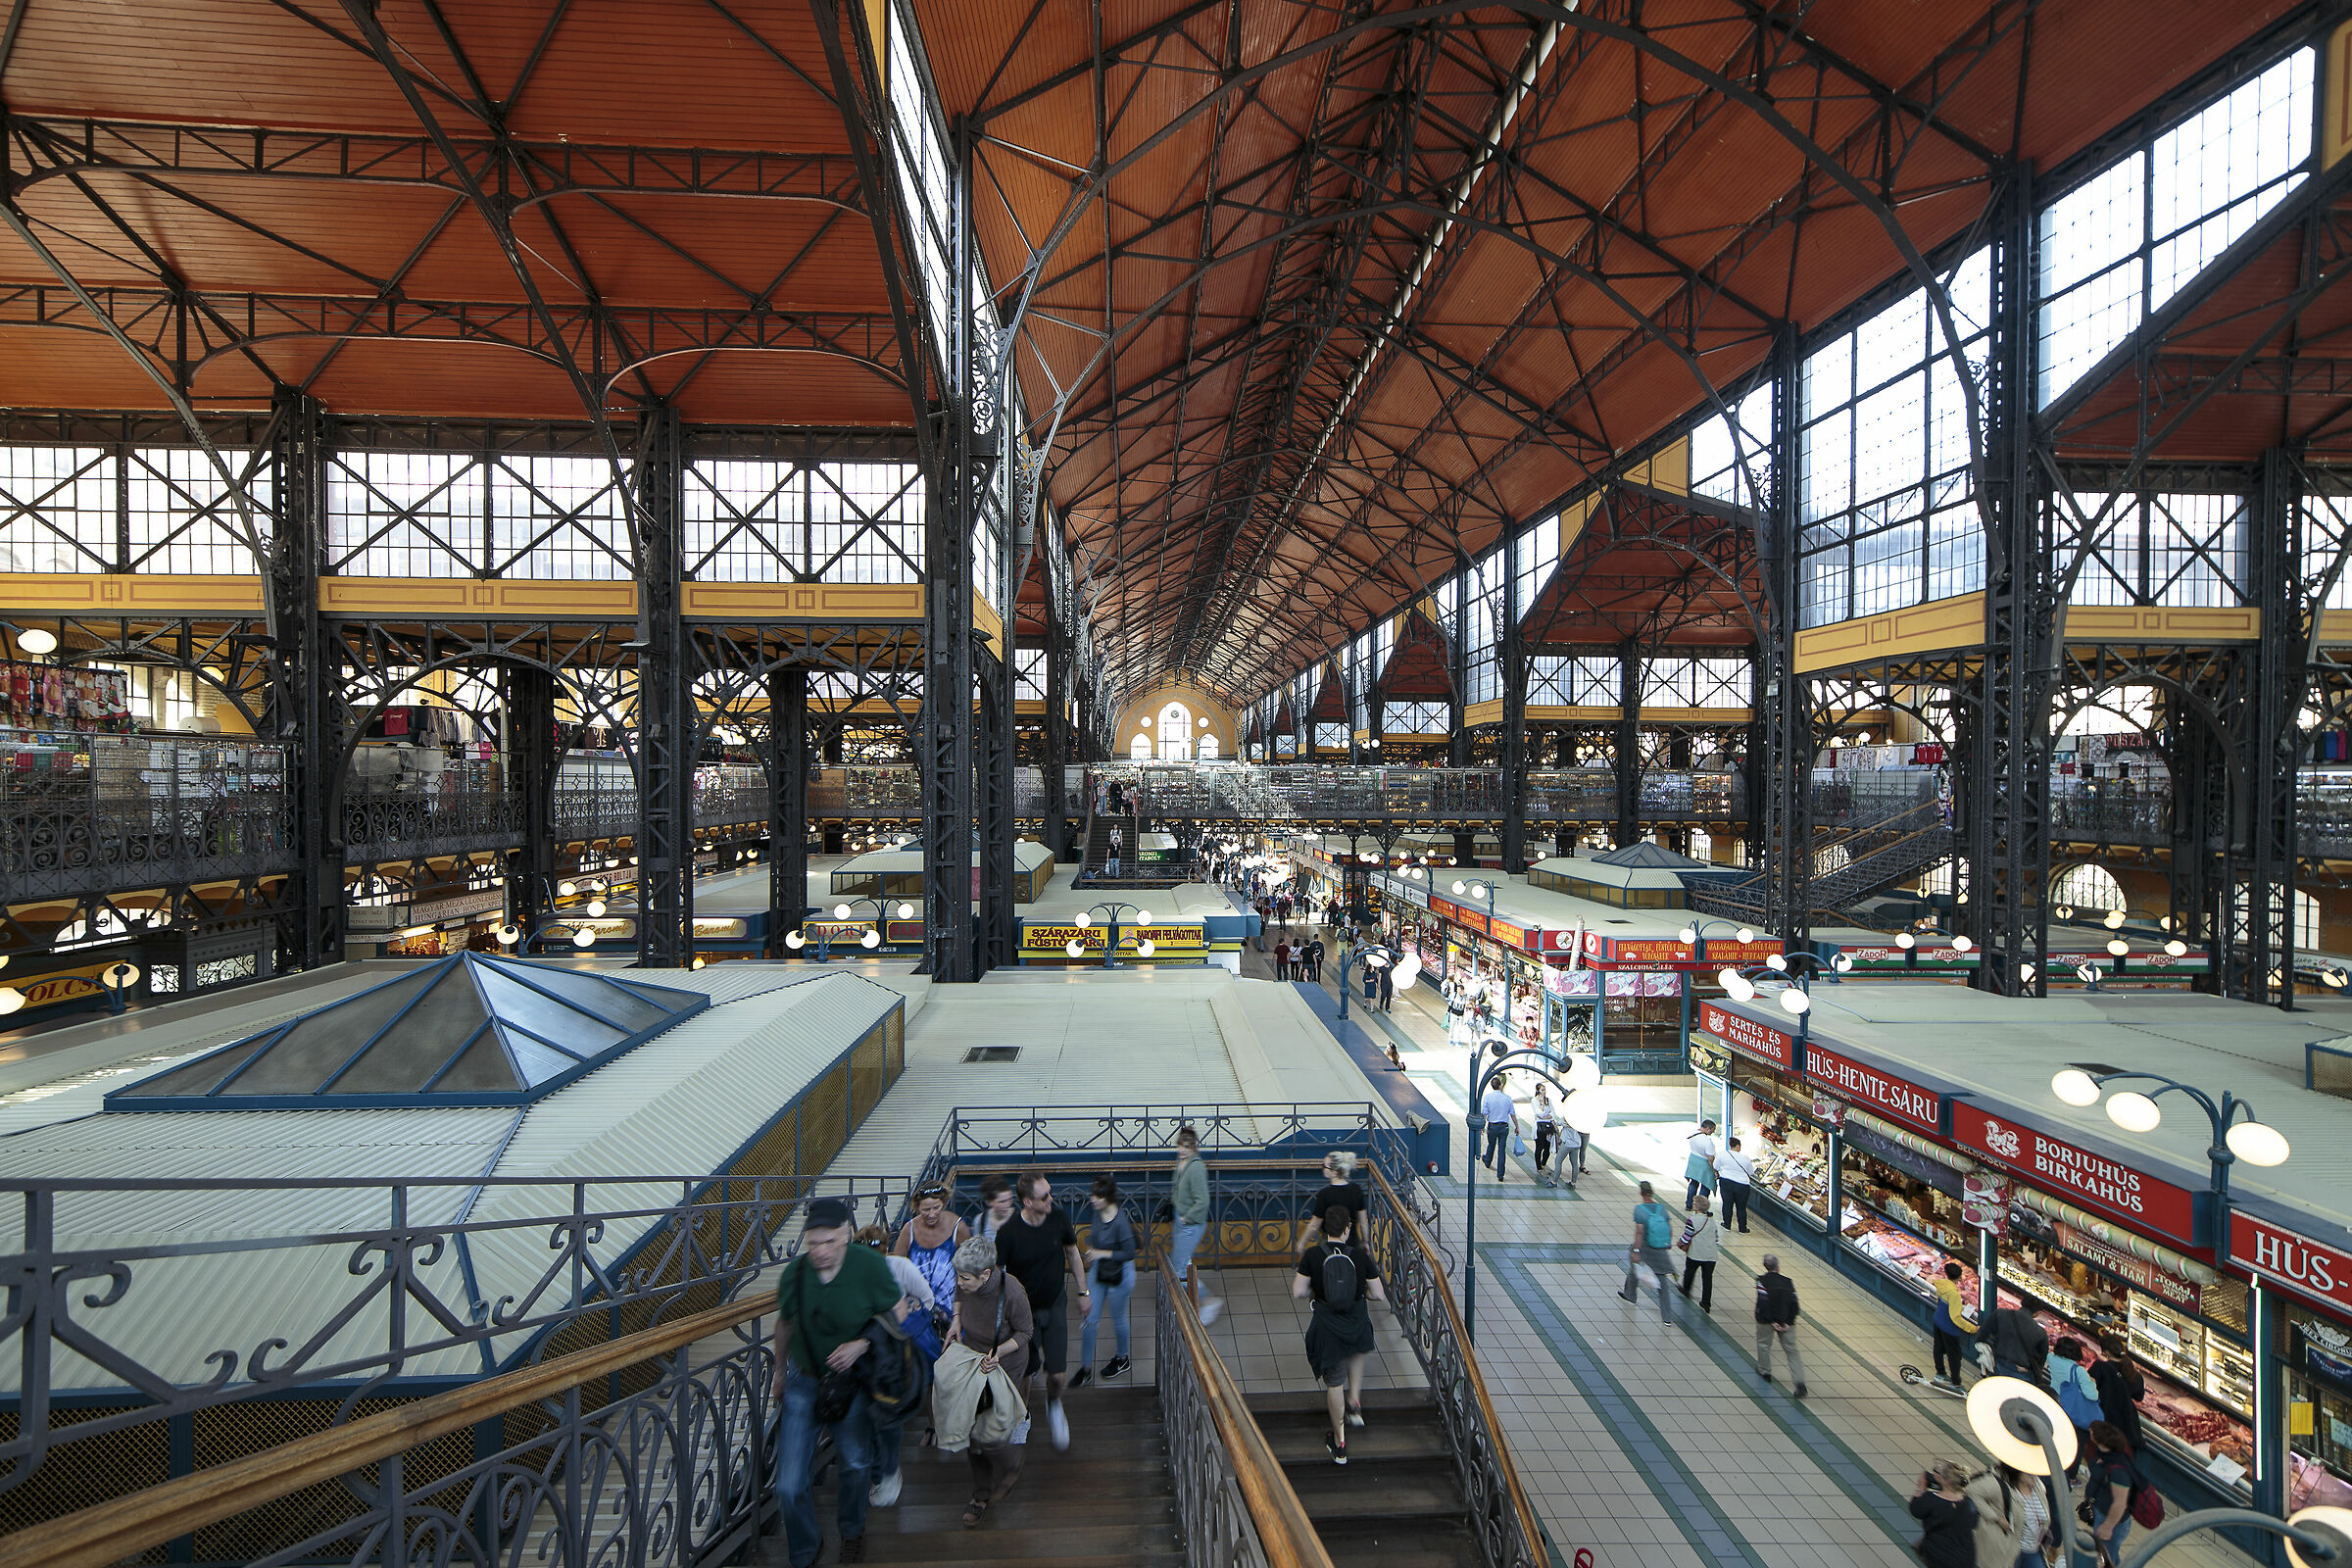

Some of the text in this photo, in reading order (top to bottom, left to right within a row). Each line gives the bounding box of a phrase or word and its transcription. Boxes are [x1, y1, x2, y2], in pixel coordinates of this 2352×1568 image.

[413, 903, 444, 914] MAGYAR
[415, 907, 462, 922] HUNGARIAN
[464, 903, 486, 914] HONEY
[1031, 926, 1102, 938] SZÁRAZÁRU
[1162, 926, 1201, 941] FELVÁGOTTAK
[1728, 1027, 1783, 1058] MARHAHÚS
[1730, 1014, 1782, 1045] SERTÉS ÉS
[2034, 1136, 2141, 1193] BORJUHÚS
[2034, 1153, 2144, 1214] BIRKAHÚS
[2066, 1238, 2106, 1267] SALAMI
[2108, 1260, 2117, 1272] &
[2120, 1264, 2145, 1287] HAM
[2157, 1273, 2191, 1296] TOKAJ
